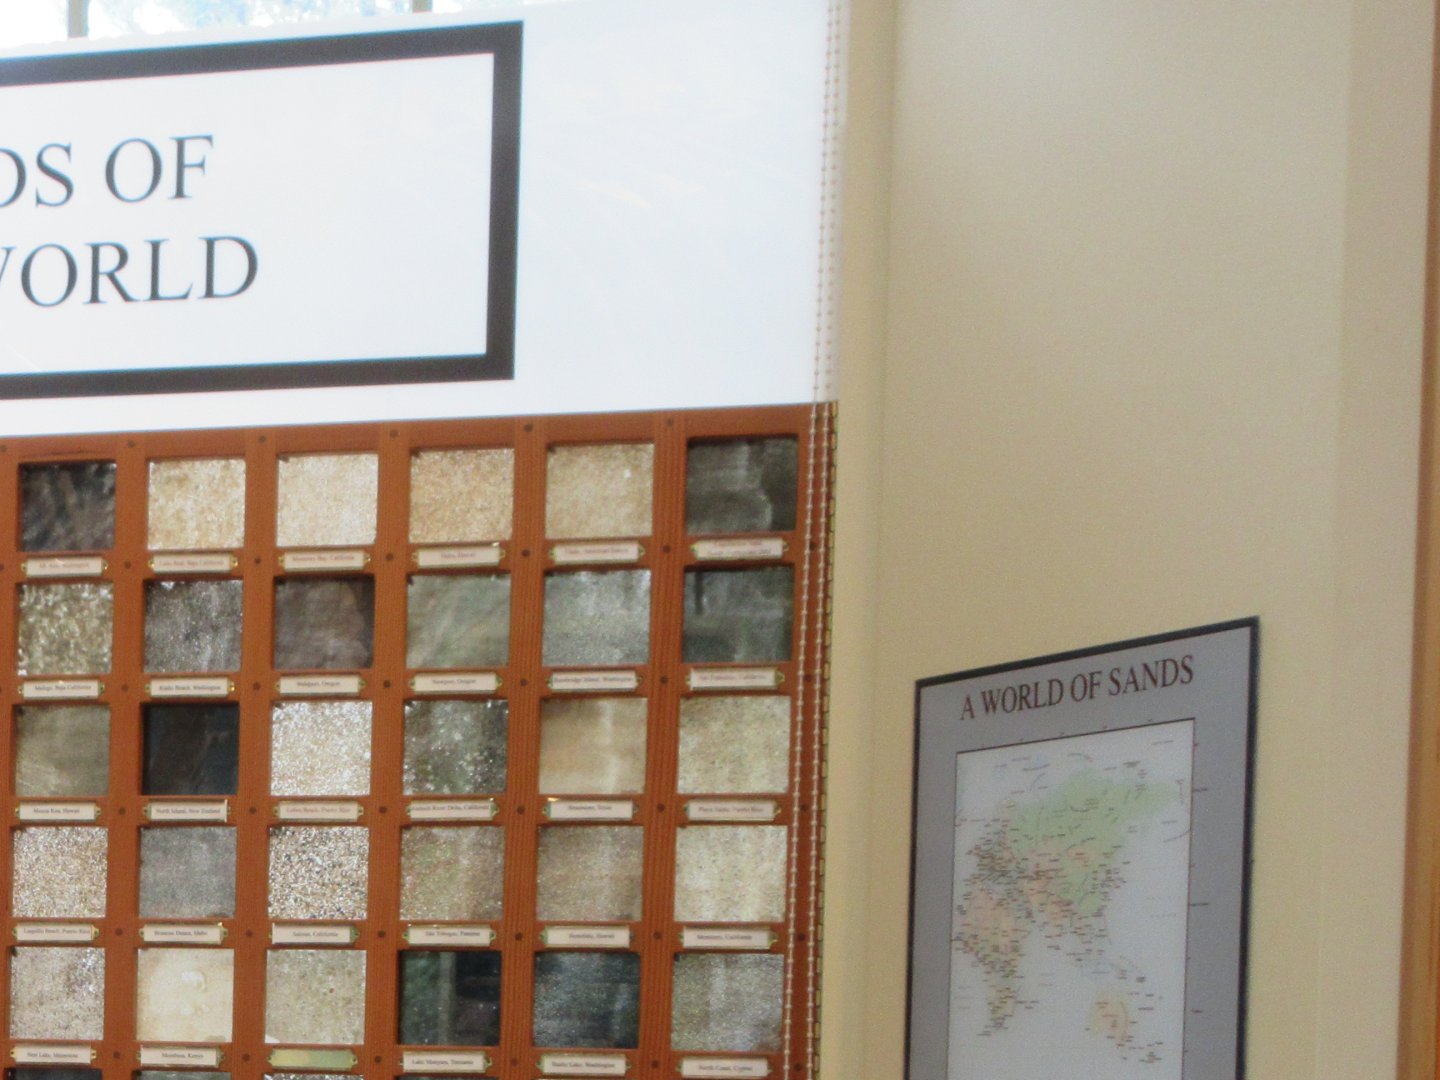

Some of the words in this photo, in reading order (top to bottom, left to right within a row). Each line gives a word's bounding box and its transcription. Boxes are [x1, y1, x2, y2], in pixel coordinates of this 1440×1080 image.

[104, 134, 213, 203] OF
[961, 694, 974, 720] A
[981, 679, 1063, 715] WORLD
[1070, 670, 1102, 701] OF
[1109, 655, 1193, 696] SANDS
